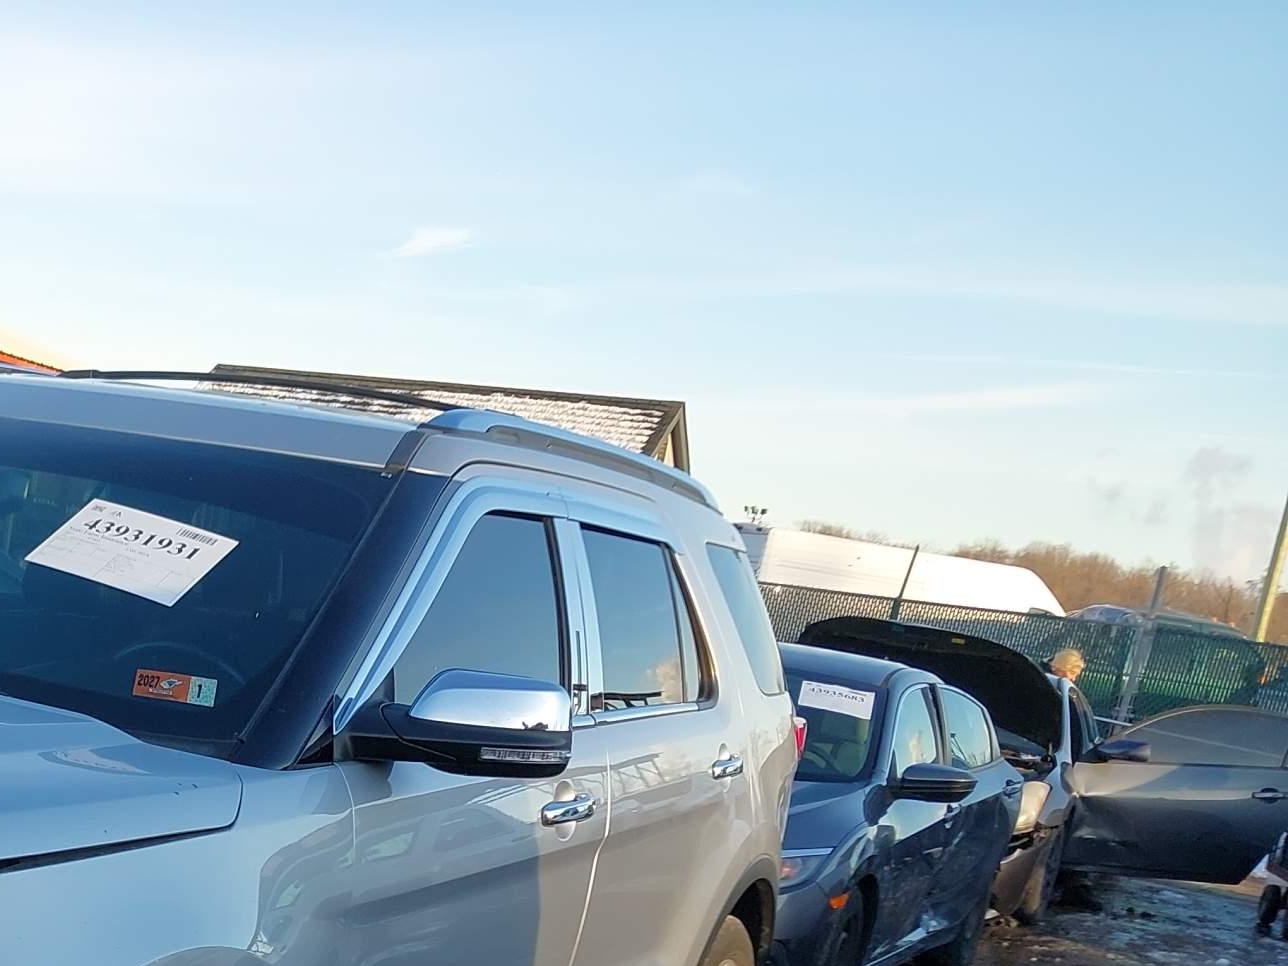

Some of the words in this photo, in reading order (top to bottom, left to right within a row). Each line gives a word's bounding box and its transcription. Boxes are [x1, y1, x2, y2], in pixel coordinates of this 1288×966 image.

[83, 518, 201, 560] 43931931
[137, 674, 161, 688] 2027
[197, 684, 203, 699] 1
